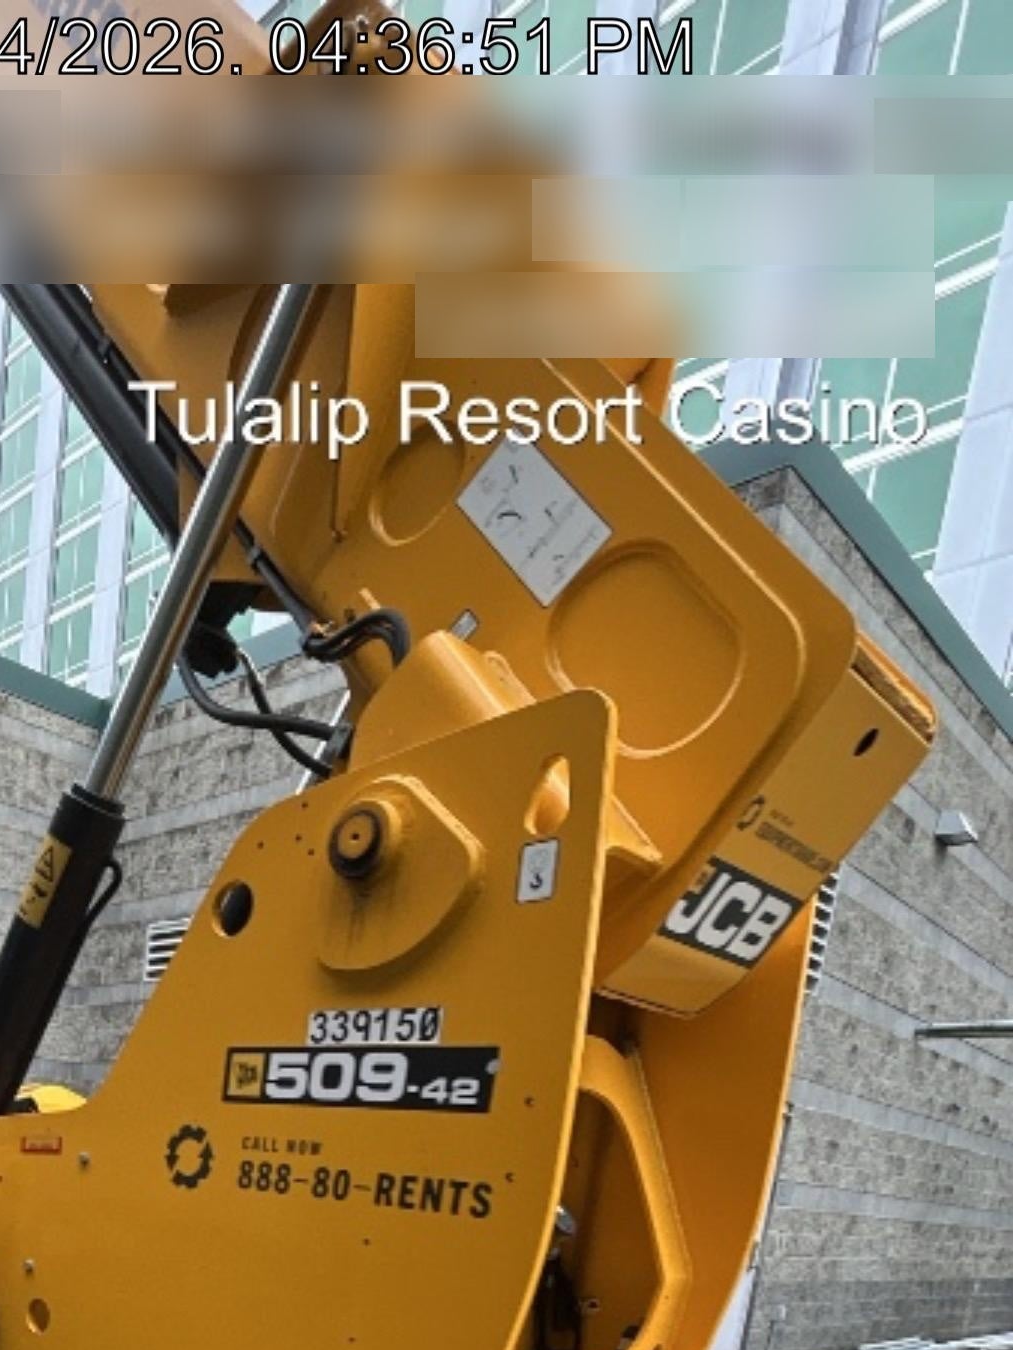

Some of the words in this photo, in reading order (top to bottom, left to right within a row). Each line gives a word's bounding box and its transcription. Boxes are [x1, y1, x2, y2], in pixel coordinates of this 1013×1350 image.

[665, 871, 792, 961] JCB
[310, 1006, 440, 1044] 339150
[265, 1052, 481, 1105] 509-42
[242, 1136, 279, 1153] CALL
[287, 1139, 323, 1156] NOW
[237, 1160, 493, 1219] 888-80-RENTS
